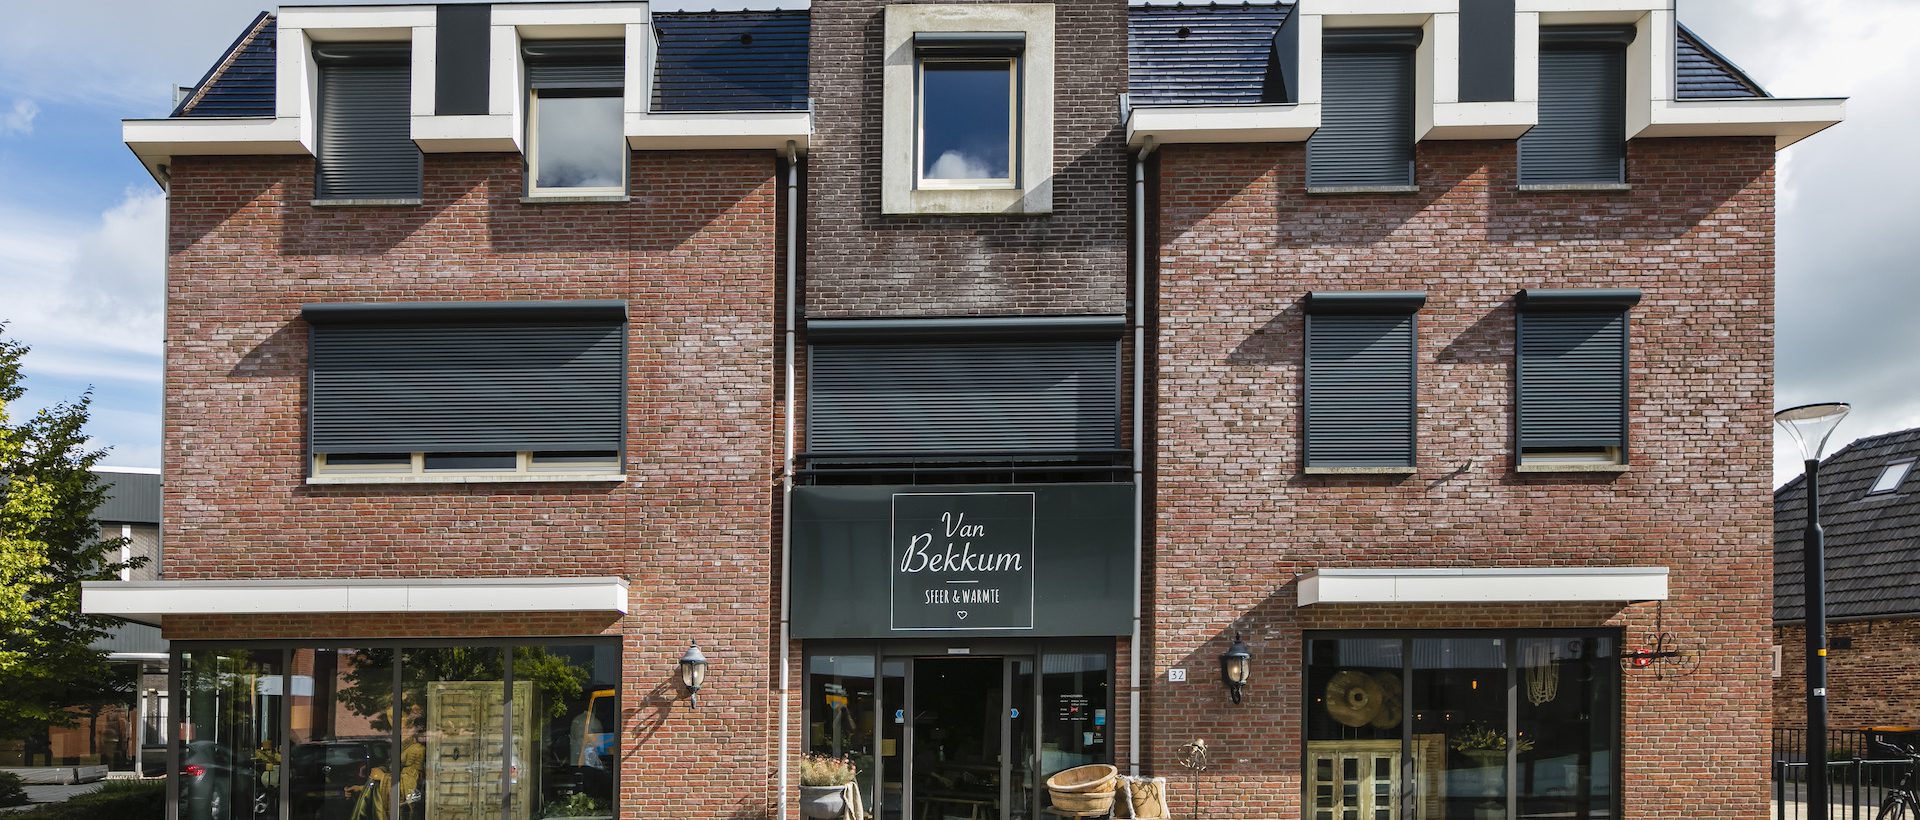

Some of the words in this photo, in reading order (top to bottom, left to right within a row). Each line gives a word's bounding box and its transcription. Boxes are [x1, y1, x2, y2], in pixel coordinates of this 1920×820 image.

[941, 511, 985, 538] Van
[900, 532, 1023, 573] Bekkum
[925, 589, 950, 604] SFEER
[952, 589, 961, 604] &
[962, 589, 1000, 604] WARMTE
[1171, 670, 1184, 680] 32
